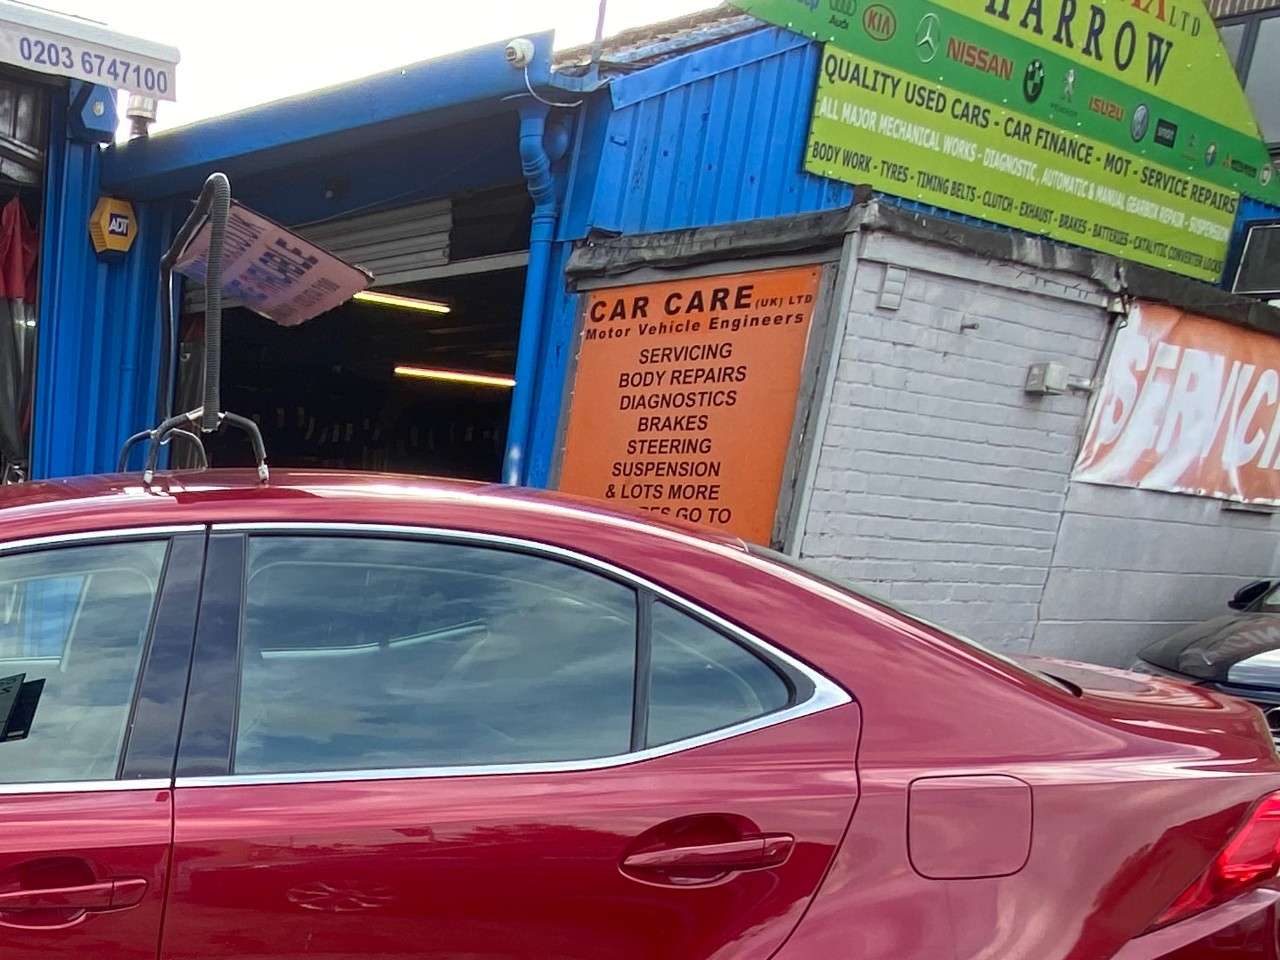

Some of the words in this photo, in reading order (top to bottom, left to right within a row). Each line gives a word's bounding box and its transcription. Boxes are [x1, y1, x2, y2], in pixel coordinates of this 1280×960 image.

[867, 10, 891, 36] KIA
[1168, 6, 1201, 37] LTD
[19, 36, 74, 69] 0203
[80, 51, 168, 94] 6747100
[946, 37, 1014, 81] NISSAN
[1088, 96, 1126, 122] ISUZU
[819, 96, 839, 120] ALL
[841, 102, 877, 132] MAJOR
[878, 115, 940, 151] MECHANICAL
[942, 135, 978, 162] WORKS
[1041, 168, 1089, 198] AUTOMATIC
[824, 54, 902, 98] QUALITY
[904, 81, 947, 113] USED
[951, 98, 991, 129] CARS
[1004, 117, 1032, 144] CAR
[1035, 128, 1094, 165] FINANCE
[1103, 152, 1132, 177] MOT
[1140, 166, 1190, 198] SERVICE
[1191, 184, 1236, 214] REPAIRS
[812, 141, 842, 164] BODY
[842, 149, 872, 173] WORK
[880, 160, 909, 183] TYRES
[916, 171, 950, 194] TIMING
[950, 180, 977, 202] BELTS
[982, 190, 1014, 213] CLUTCH
[1019, 201, 1054, 224] EXHAUST
[1058, 213, 1088, 234] BRAKES
[1092, 223, 1129, 246] BATTERIES
[1133, 236, 1168, 258] CATALYTIC
[109, 216, 129, 234] ADT
[590, 296, 649, 323] CAR
[663, 285, 755, 316] CARE
[788, 293, 813, 306] LTD
[585, 326, 631, 341] Motor
[638, 319, 701, 337] Vehicle
[708, 312, 805, 333] Engineers
[638, 342, 733, 365] SERVICING
[619, 371, 666, 389] BODY
[669, 365, 747, 386] REPAIRS
[619, 390, 737, 411] DIAGNOSTICS
[637, 415, 709, 433] BRAKES
[626, 438, 712, 455] STEERING
[611, 461, 721, 478] SUSPENSION
[605, 484, 616, 499] &
[620, 484, 663, 500] LOTS
[668, 484, 721, 500] MORE
[675, 507, 702, 524] GO
[707, 507, 732, 524] TO
